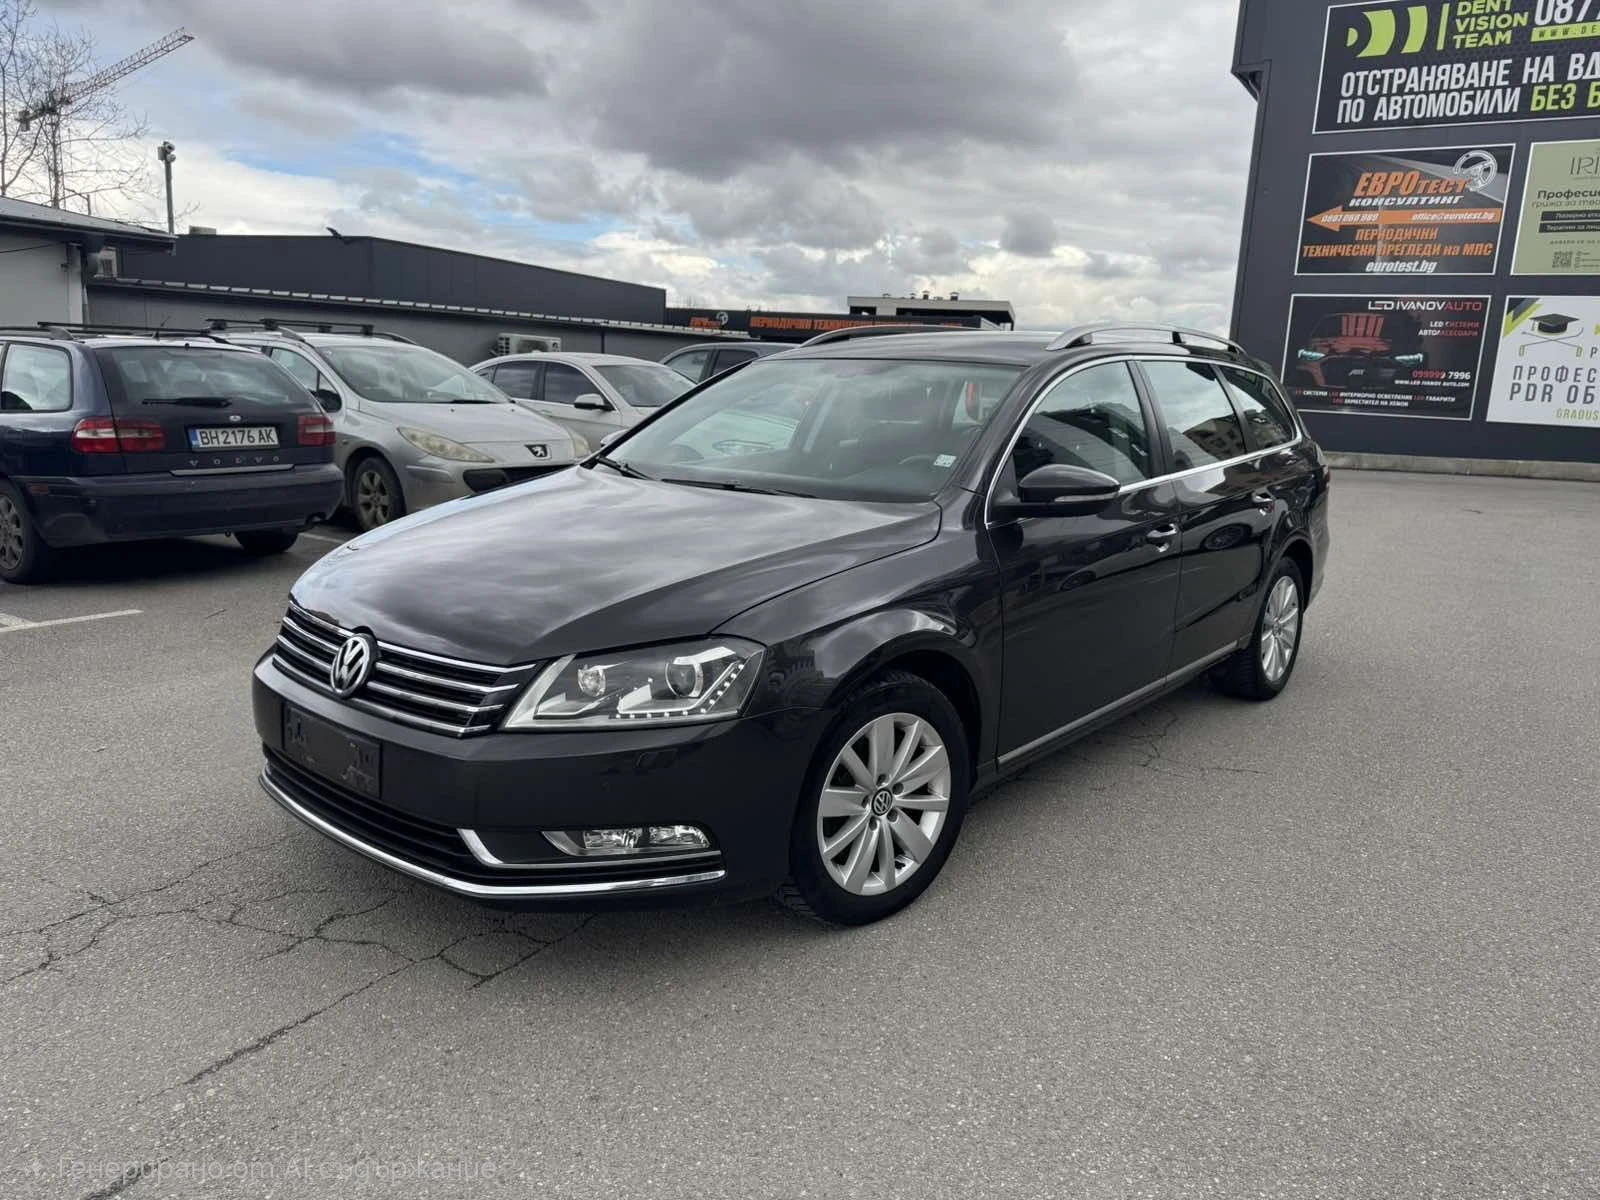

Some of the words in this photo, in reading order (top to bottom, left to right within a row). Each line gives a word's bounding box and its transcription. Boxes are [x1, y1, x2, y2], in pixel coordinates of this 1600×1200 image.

[1457, 0, 1513, 16] DENT
[1534, 0, 1600, 26] 087
[1456, 12, 1529, 33] VISION
[1453, 30, 1513, 49] TEAM
[1341, 59, 1513, 98] ОТСТРАНЯВАНЕ
[1522, 55, 1555, 84] НА
[1337, 98, 1366, 124] ПО
[1373, 87, 1521, 121] АВТОМОБИЛИ
[1530, 82, 1577, 112] БЕЗ
[1349, 195, 1465, 208] КОНСУЛТИНГ
[1537, 189, 1600, 201] Професи
[1355, 227, 1440, 241] ПЕРИОДИЧНИ
[1303, 245, 1377, 258] ТЕХНИЧЕСКИ
[1378, 243, 1441, 257] ПРЕГЛЕДИ
[1462, 242, 1494, 256] МПС
[1365, 259, 1438, 274] eurotest.bg
[1448, 372, 1471, 380] 7996
[1513, 365, 1598, 384] ПРОФЕС
[1509, 382, 1554, 403] PDR
[221, 429, 256, 445] 2176
